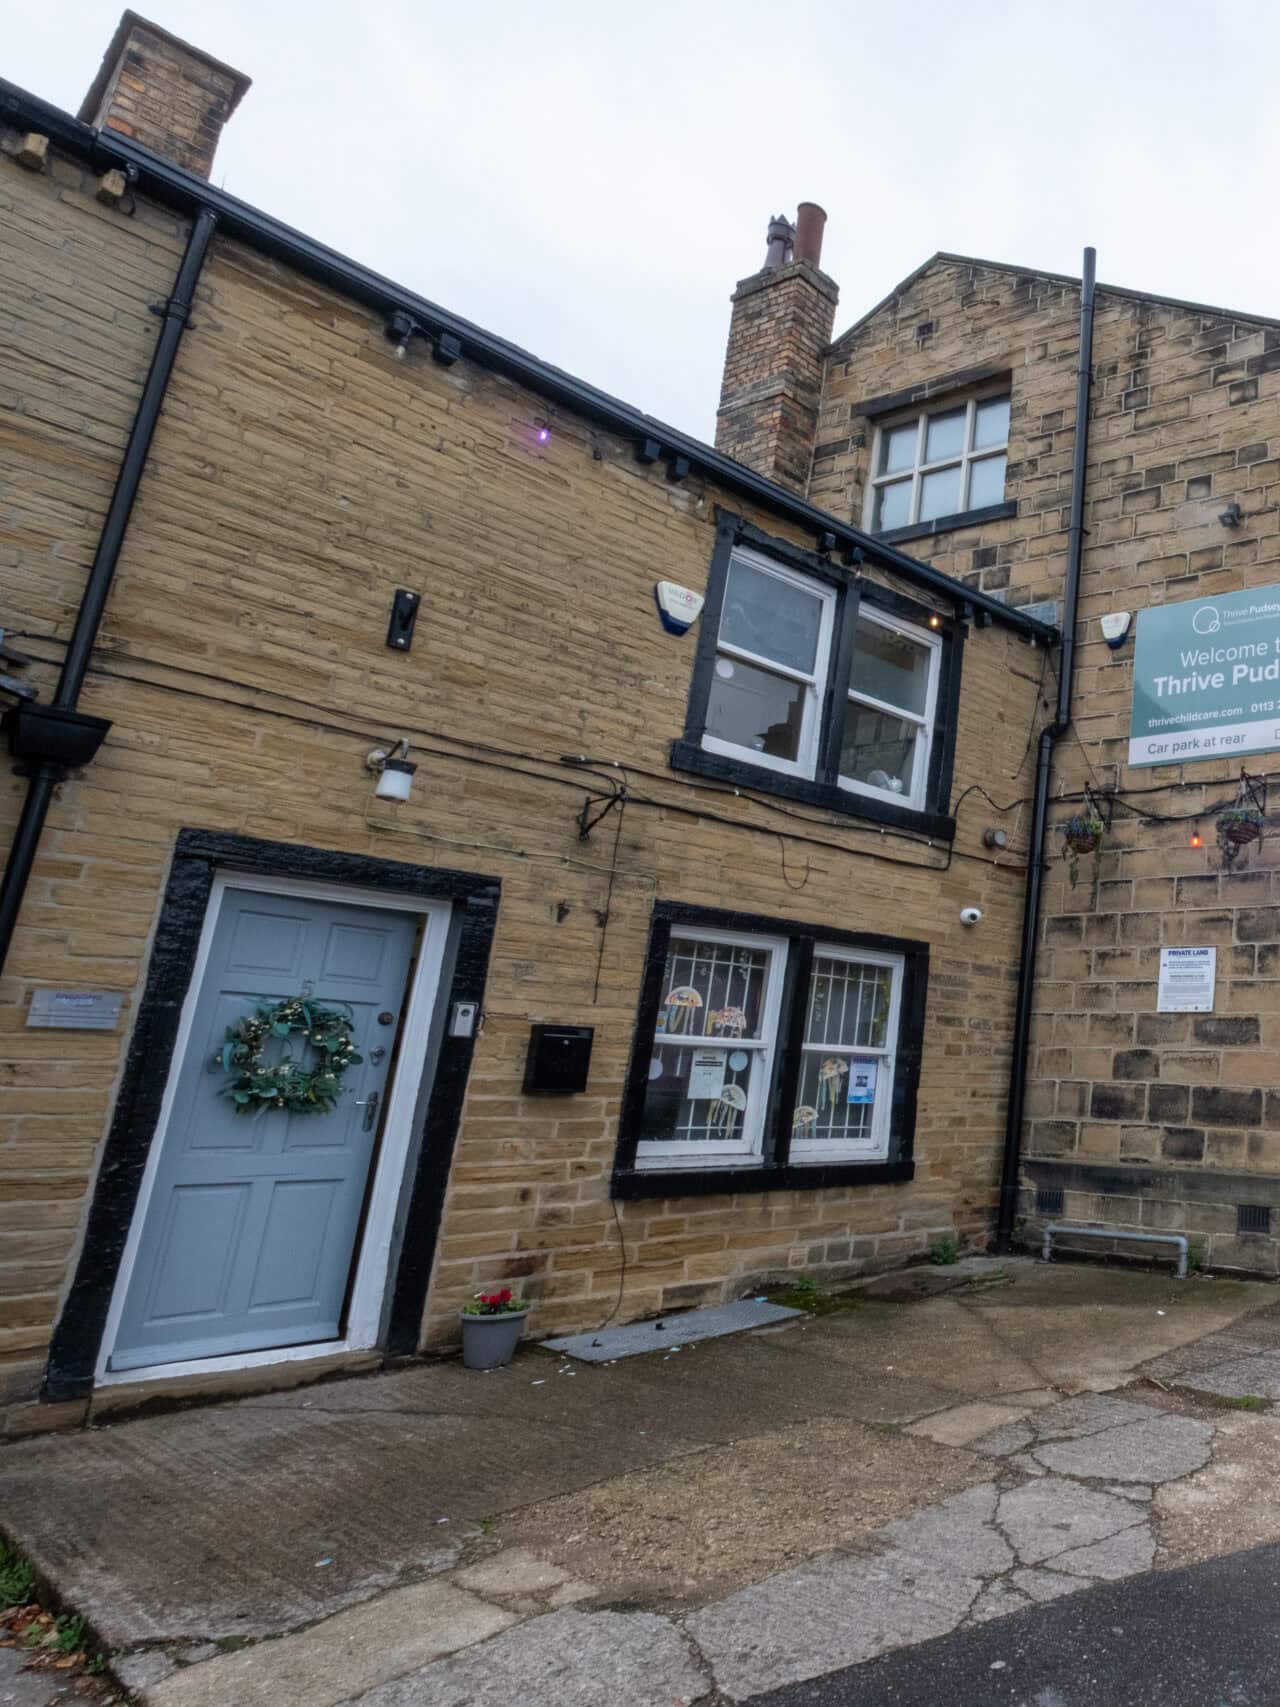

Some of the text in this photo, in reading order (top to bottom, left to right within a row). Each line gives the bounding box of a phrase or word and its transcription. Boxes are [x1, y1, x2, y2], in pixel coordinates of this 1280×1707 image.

[1180, 642, 1269, 668] Welcome
[1153, 671, 1225, 697] Thrive
[1148, 707, 1243, 728] thrivechildcare.com
[1250, 701, 1275, 713] 0113
[1147, 734, 1247, 755] Car park at rear
